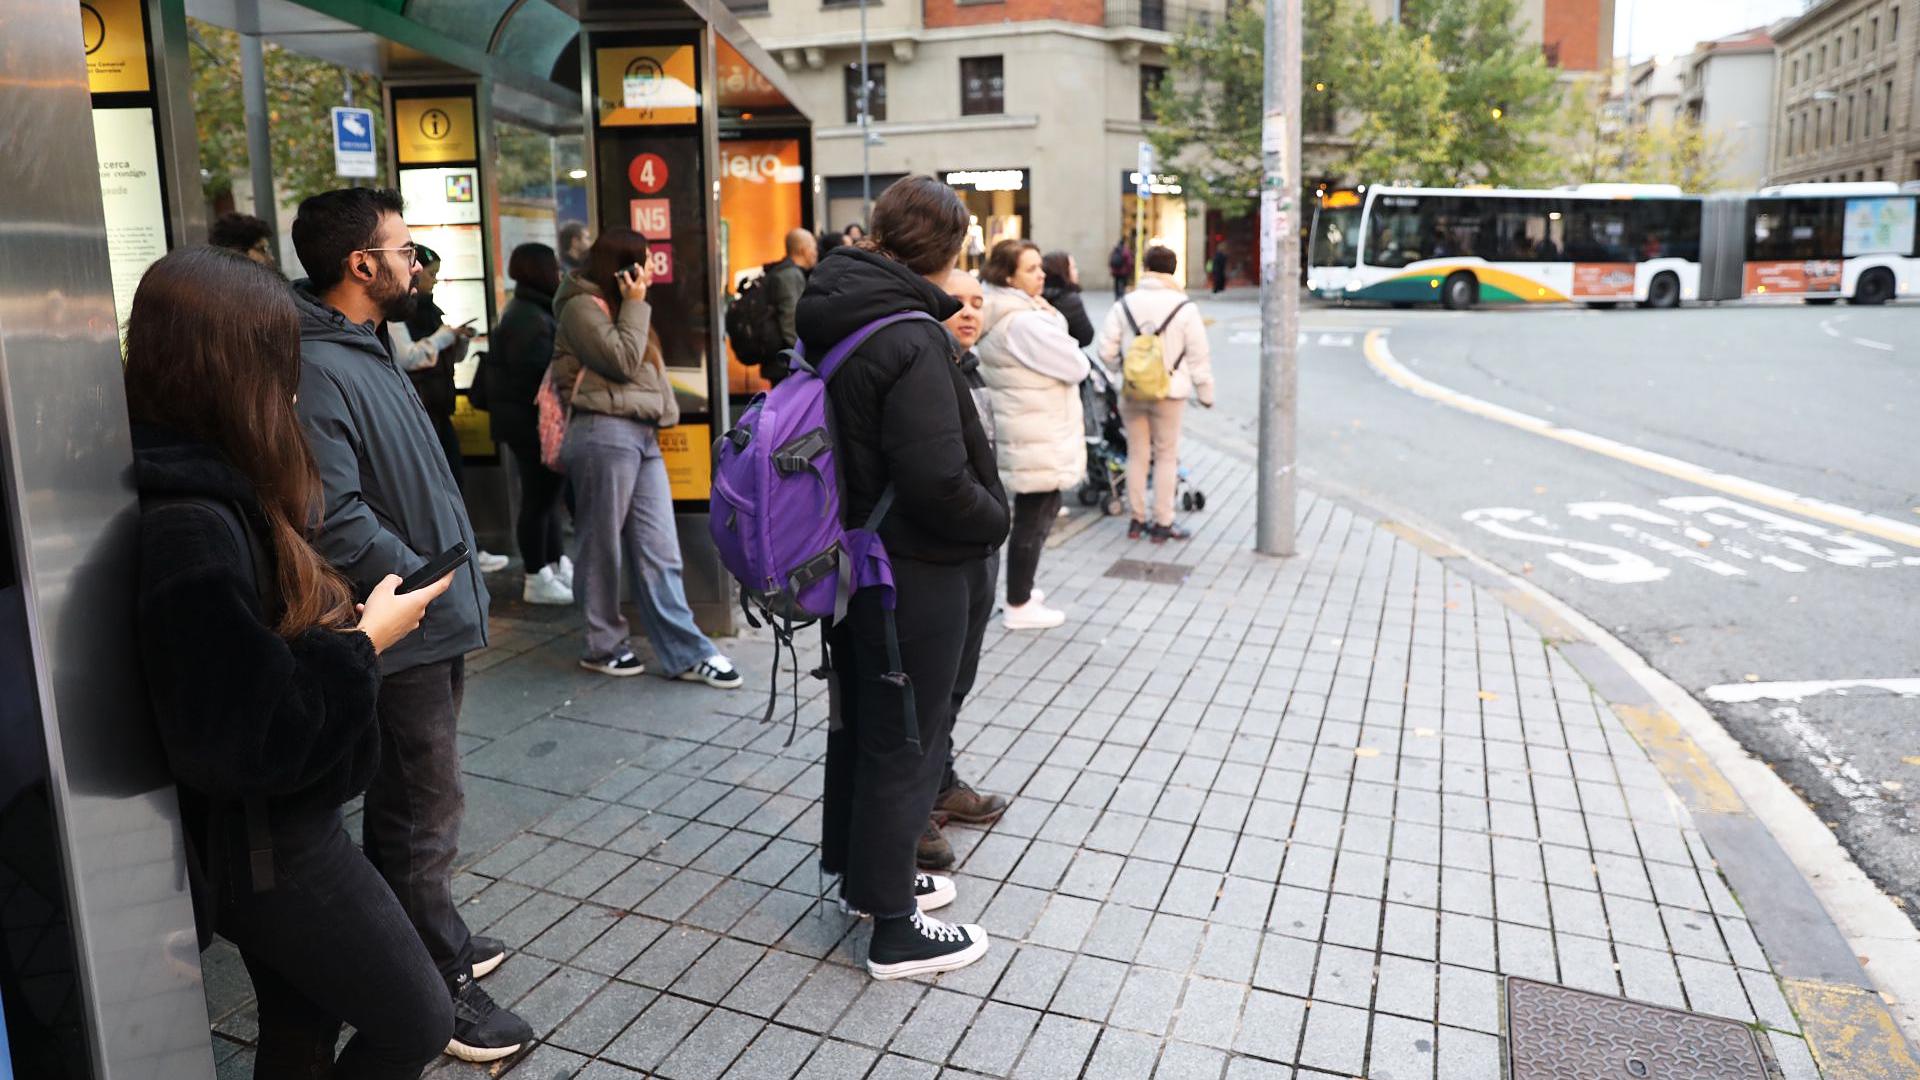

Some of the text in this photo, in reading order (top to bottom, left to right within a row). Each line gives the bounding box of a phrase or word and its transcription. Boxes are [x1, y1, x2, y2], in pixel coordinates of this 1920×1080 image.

[640, 159, 656, 188] 4
[634, 207, 666, 232] N5
[652, 250, 669, 276] 8
